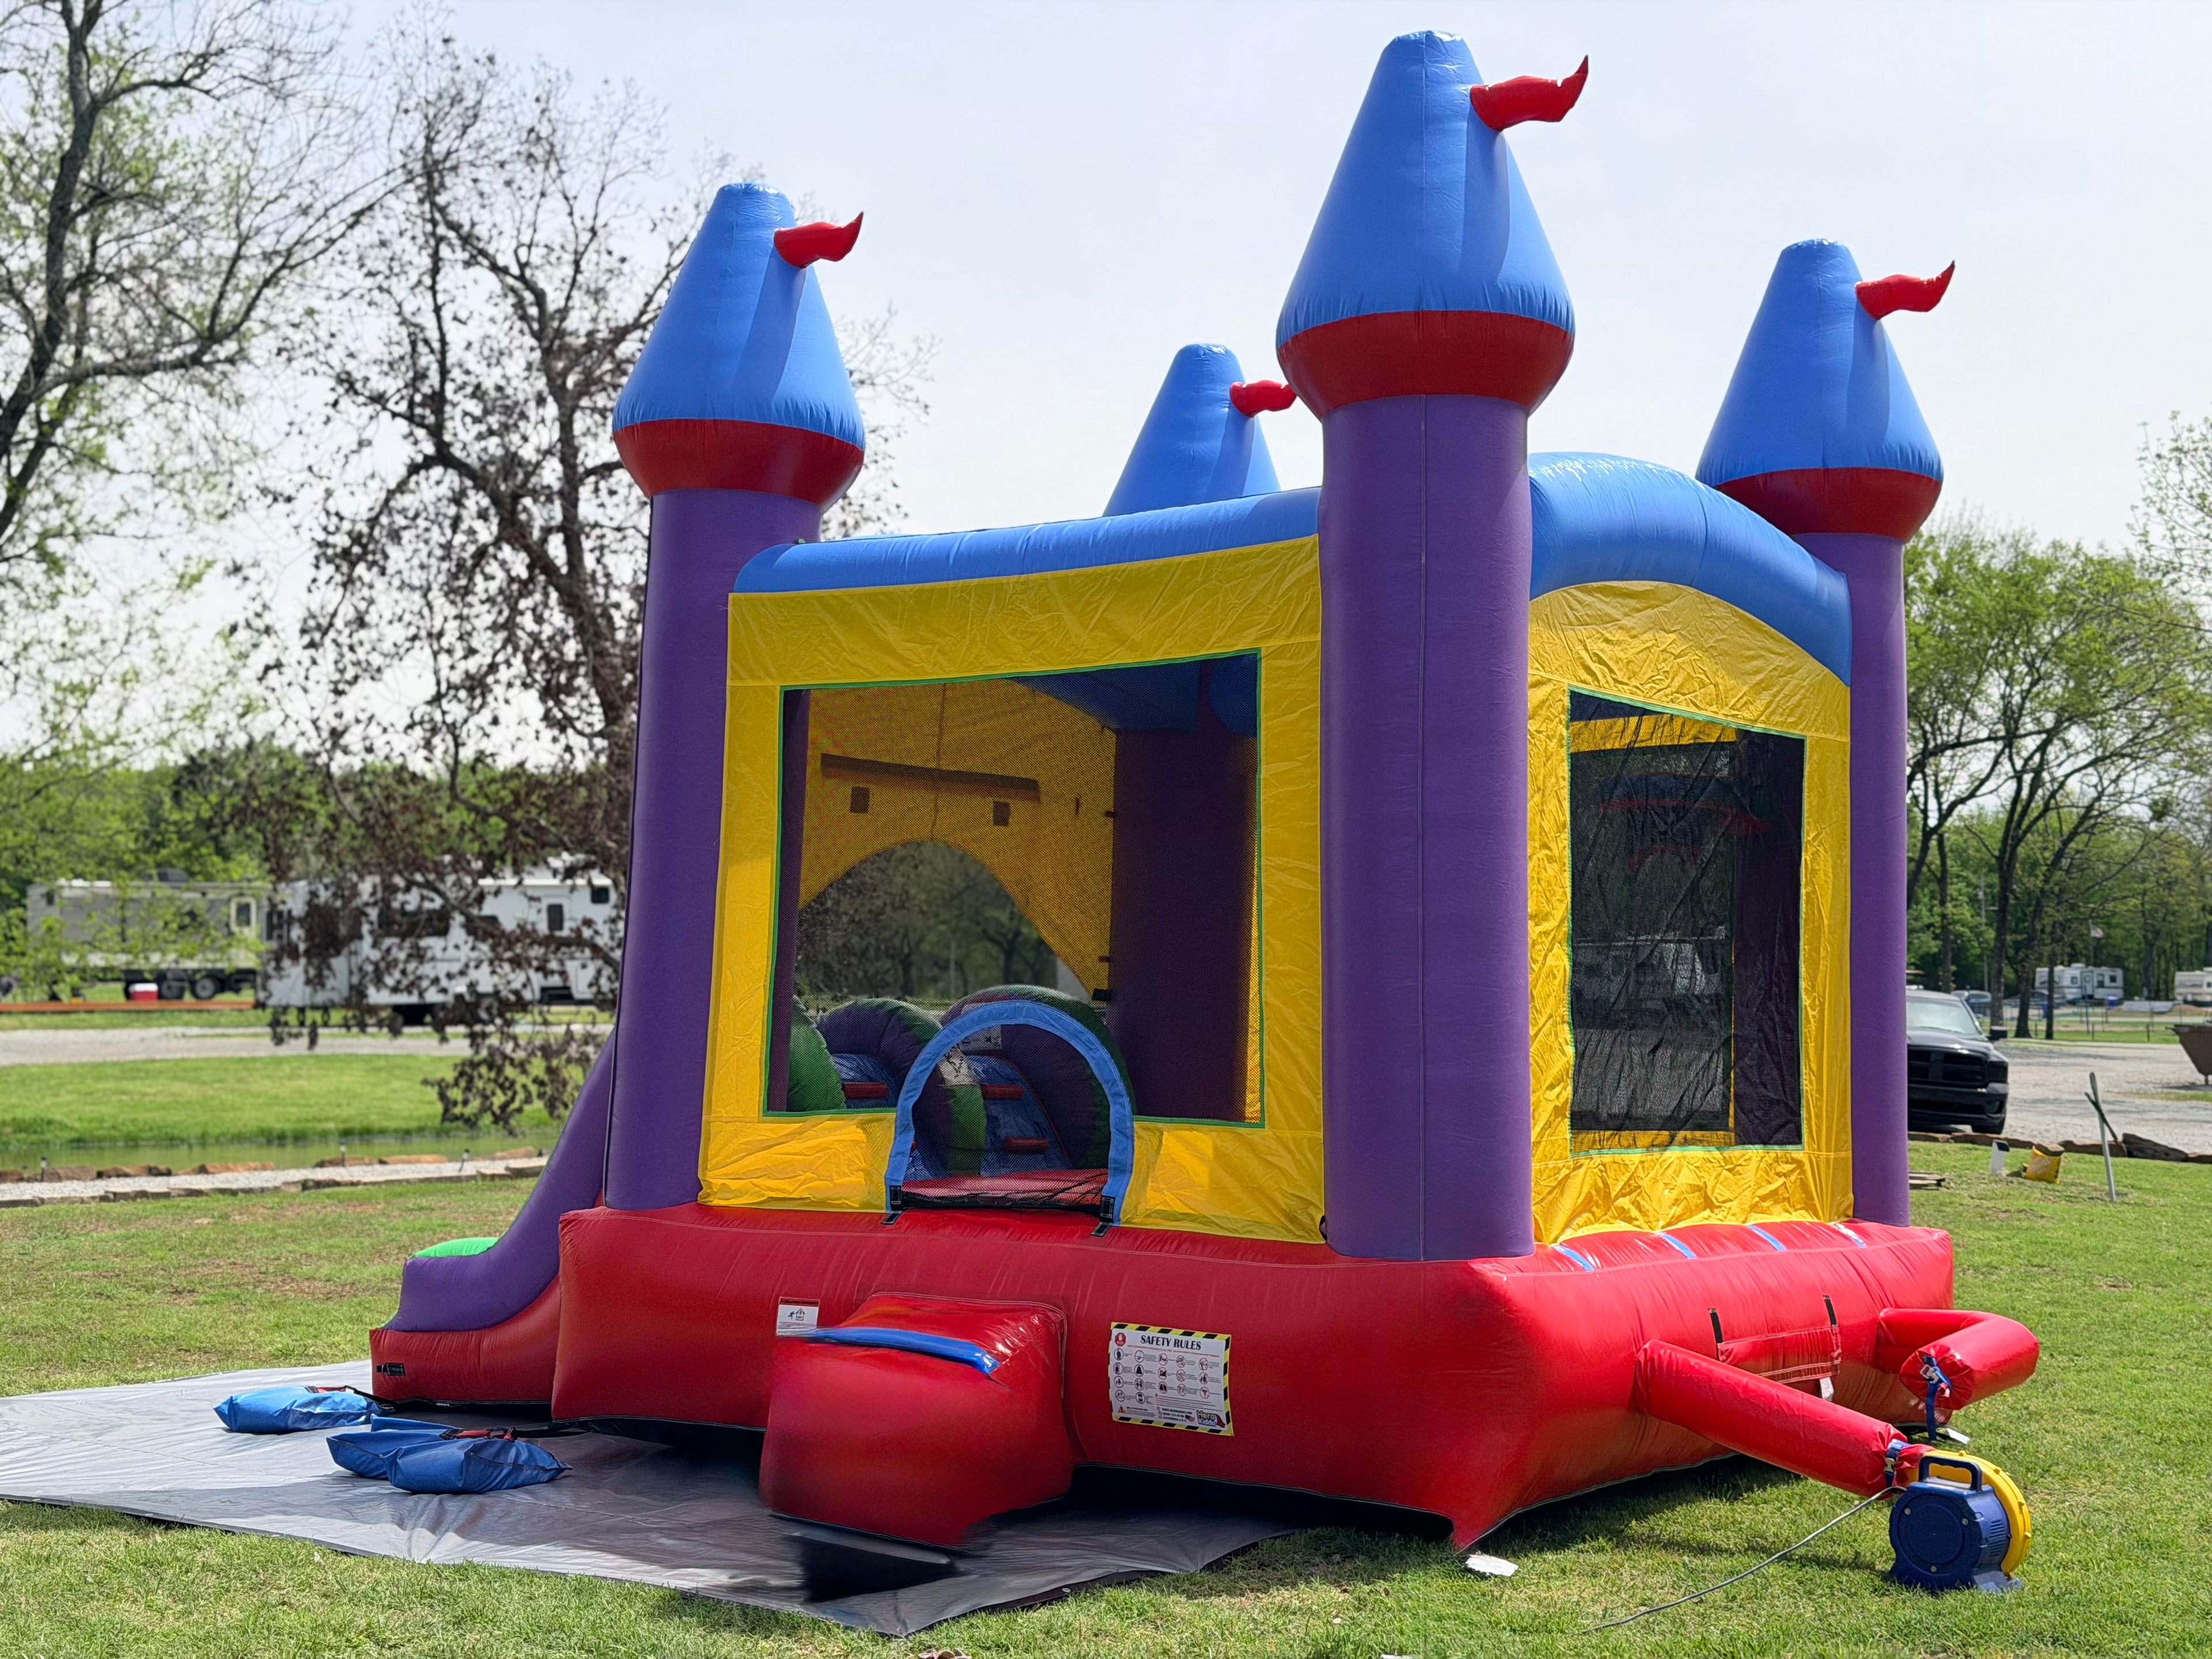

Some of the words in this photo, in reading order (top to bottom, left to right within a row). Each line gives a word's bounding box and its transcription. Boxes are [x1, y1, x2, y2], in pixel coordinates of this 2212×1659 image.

[1141, 1335, 1172, 1346] SAFETY
[1173, 1338, 1201, 1350] RULES
[1197, 1410, 1215, 1420] Hero
[1198, 1418, 1216, 1426] Kiddo
